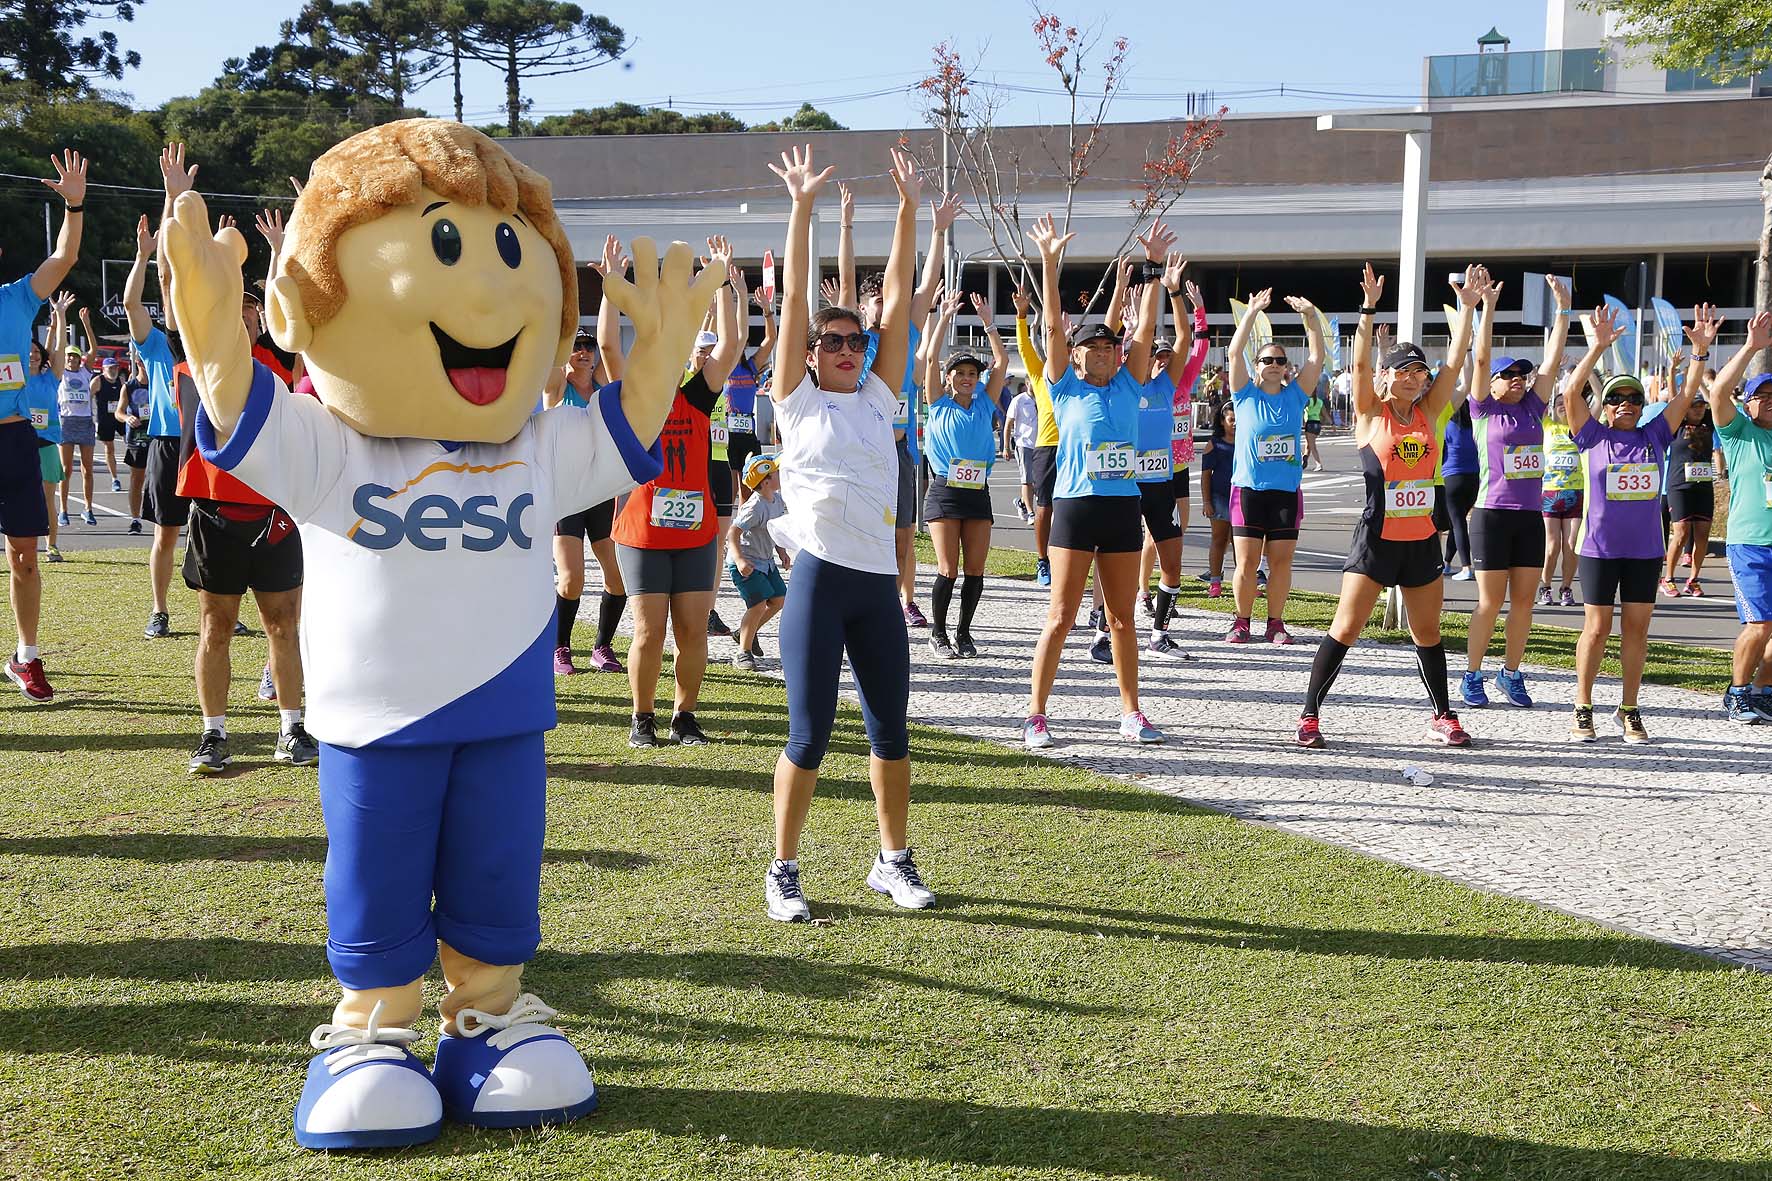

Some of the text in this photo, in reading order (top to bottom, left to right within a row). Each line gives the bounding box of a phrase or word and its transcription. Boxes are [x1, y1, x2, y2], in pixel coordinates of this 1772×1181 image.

[69, 392, 85, 400] 310
[733, 418, 750, 428] 256
[1265, 442, 1288, 455] 320
[1403, 441, 1418, 452] Km
[1096, 452, 1128, 469] 155
[1403, 451, 1419, 459] LIVRE
[1513, 454, 1540, 470] 548
[1554, 455, 1573, 465] 270
[1138, 457, 1168, 472] 1220
[956, 467, 981, 481] 587
[1690, 467, 1709, 477] 825
[1617, 474, 1651, 491] 533
[1395, 489, 1426, 508] 802
[662, 500, 697, 519] 232
[351, 482, 534, 552] Sesc
